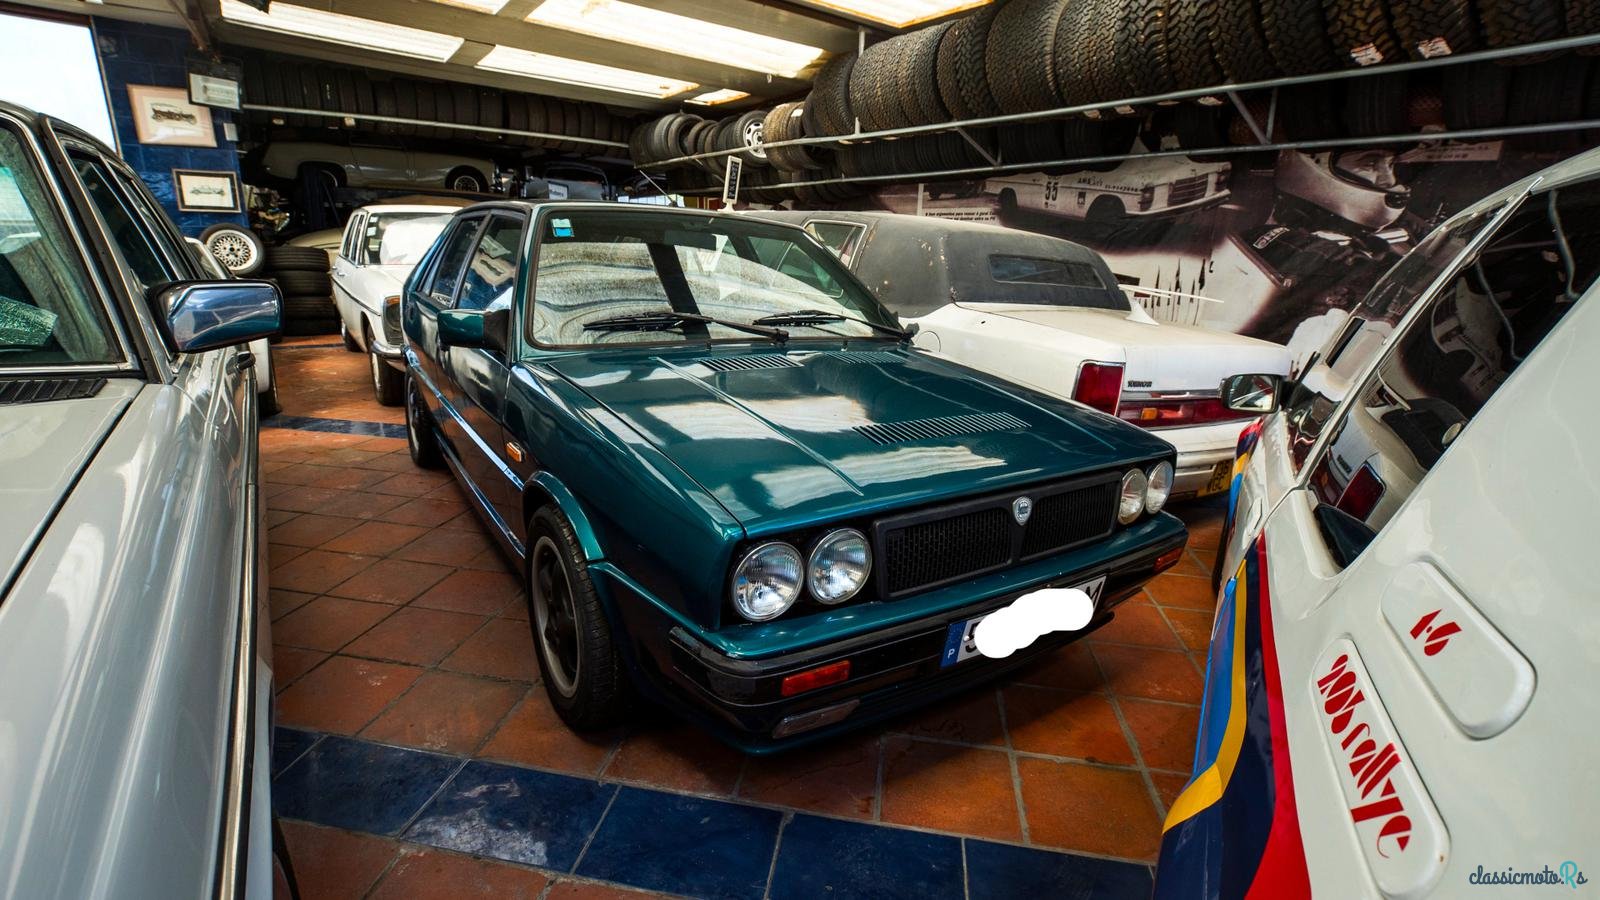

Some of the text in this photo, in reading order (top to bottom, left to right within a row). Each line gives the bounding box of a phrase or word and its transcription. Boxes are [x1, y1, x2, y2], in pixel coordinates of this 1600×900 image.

[1045, 181, 1058, 202] 55
[947, 648, 955, 659] P
[1341, 723, 1412, 858] rallye
